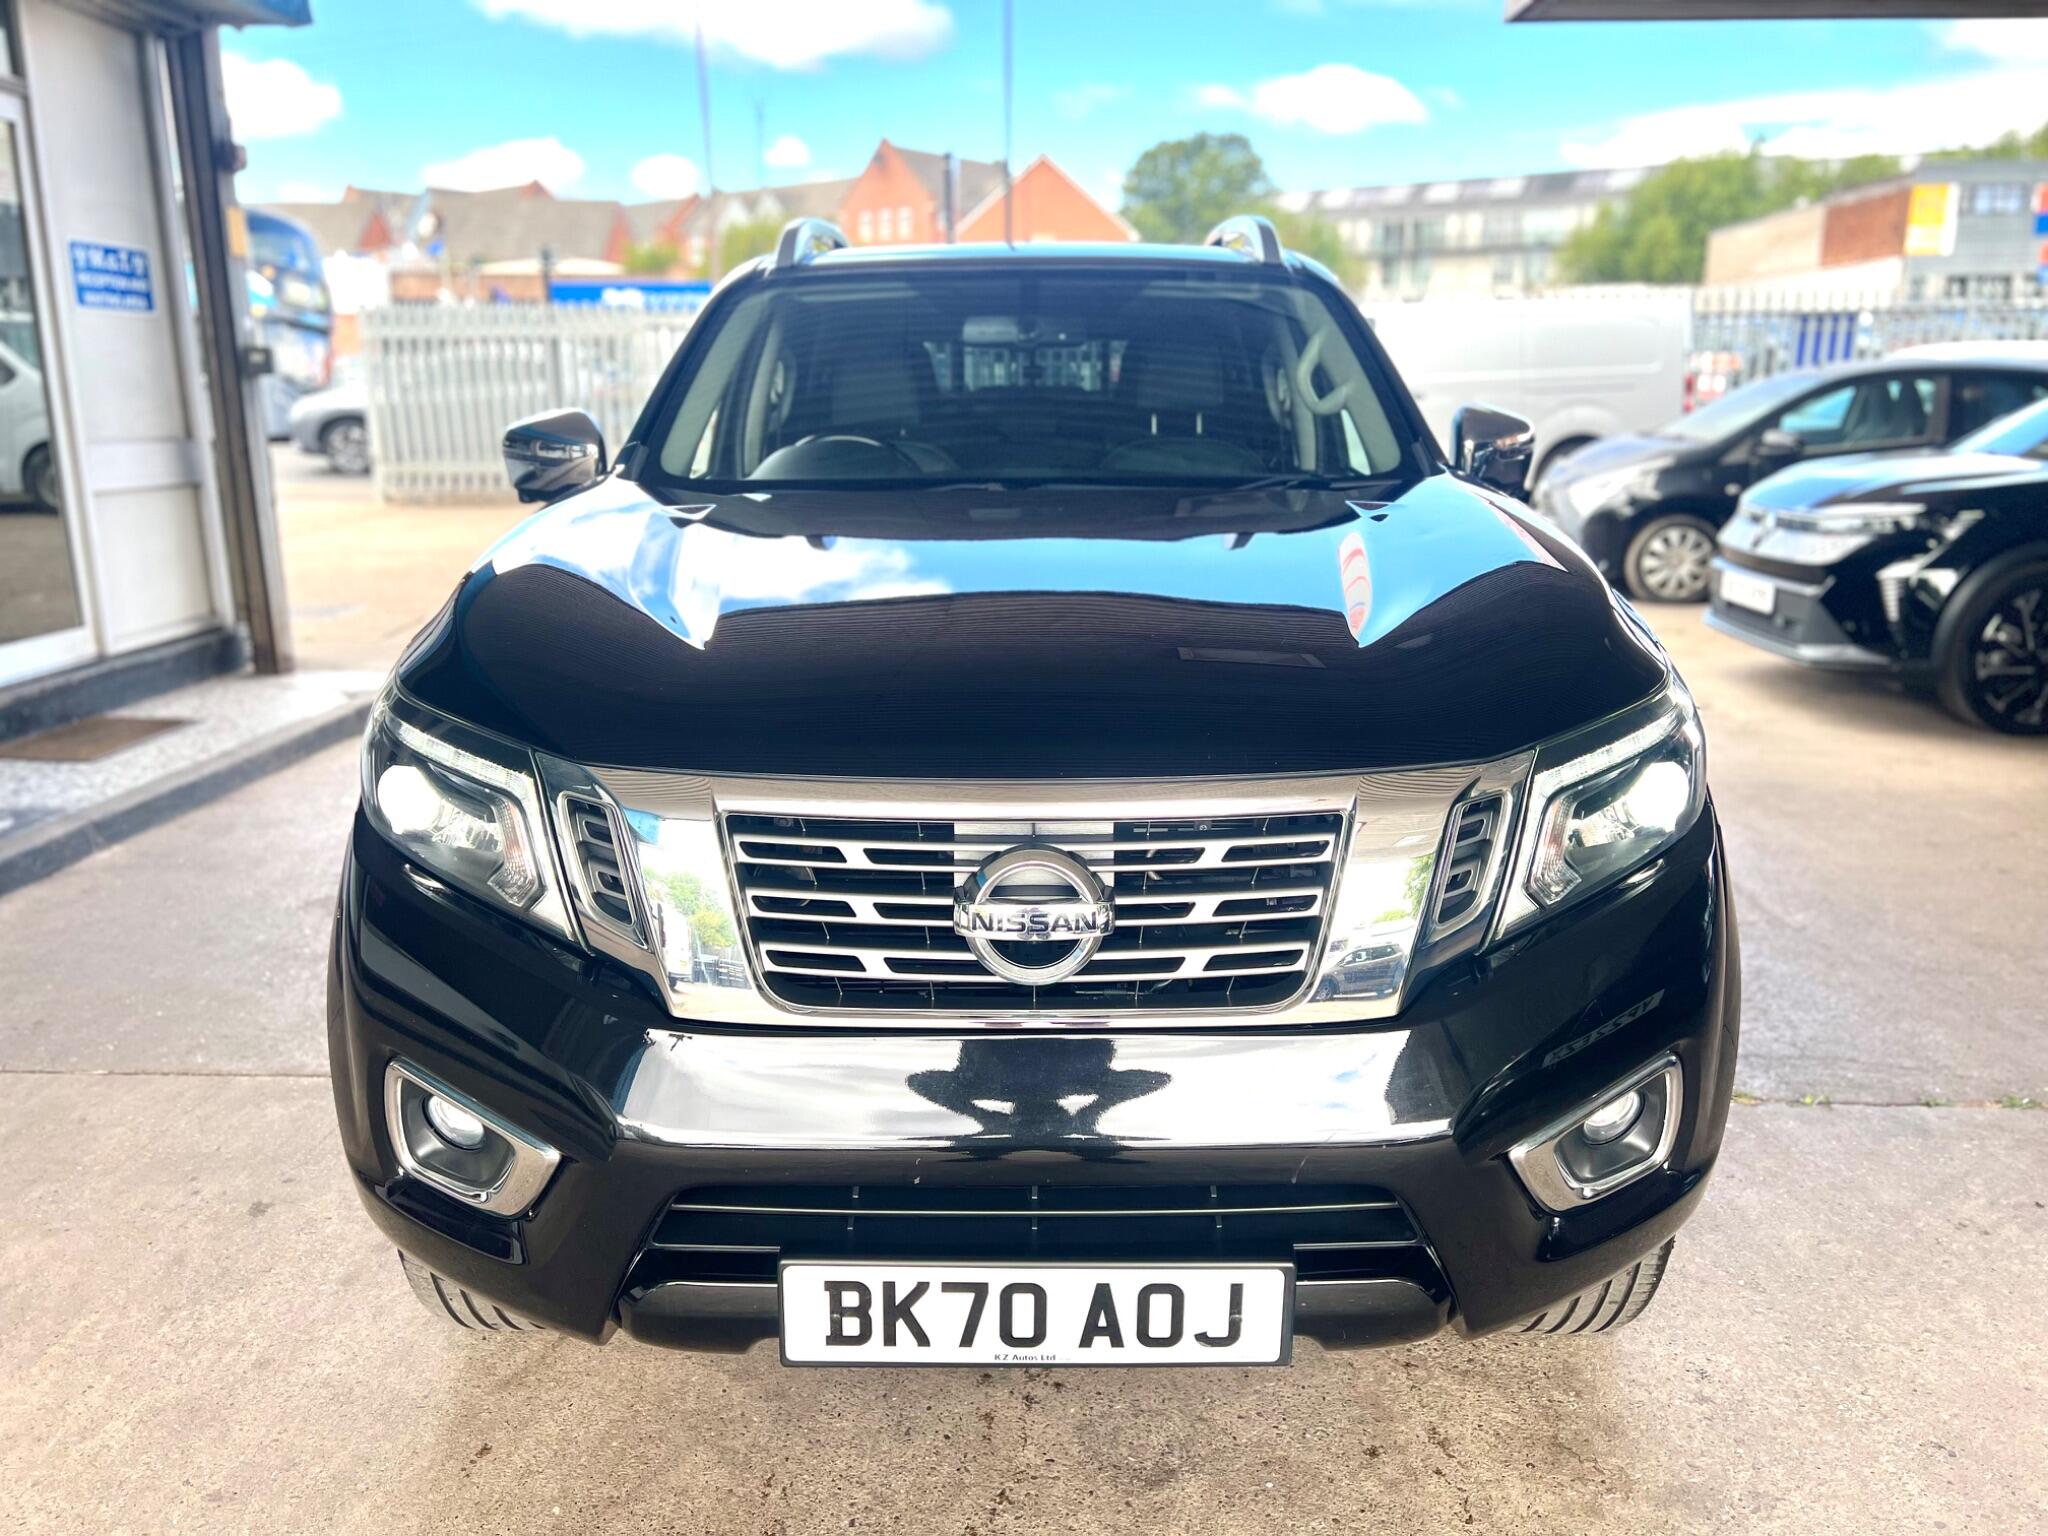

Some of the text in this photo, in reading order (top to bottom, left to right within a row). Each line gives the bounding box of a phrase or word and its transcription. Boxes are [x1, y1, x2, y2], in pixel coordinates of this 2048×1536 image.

[971, 911, 1097, 933] NISSAN
[825, 1281, 1243, 1348] BK70 AOJ
[1012, 1353, 1038, 1361] Autos
[1040, 1353, 1056, 1361] Ltd
